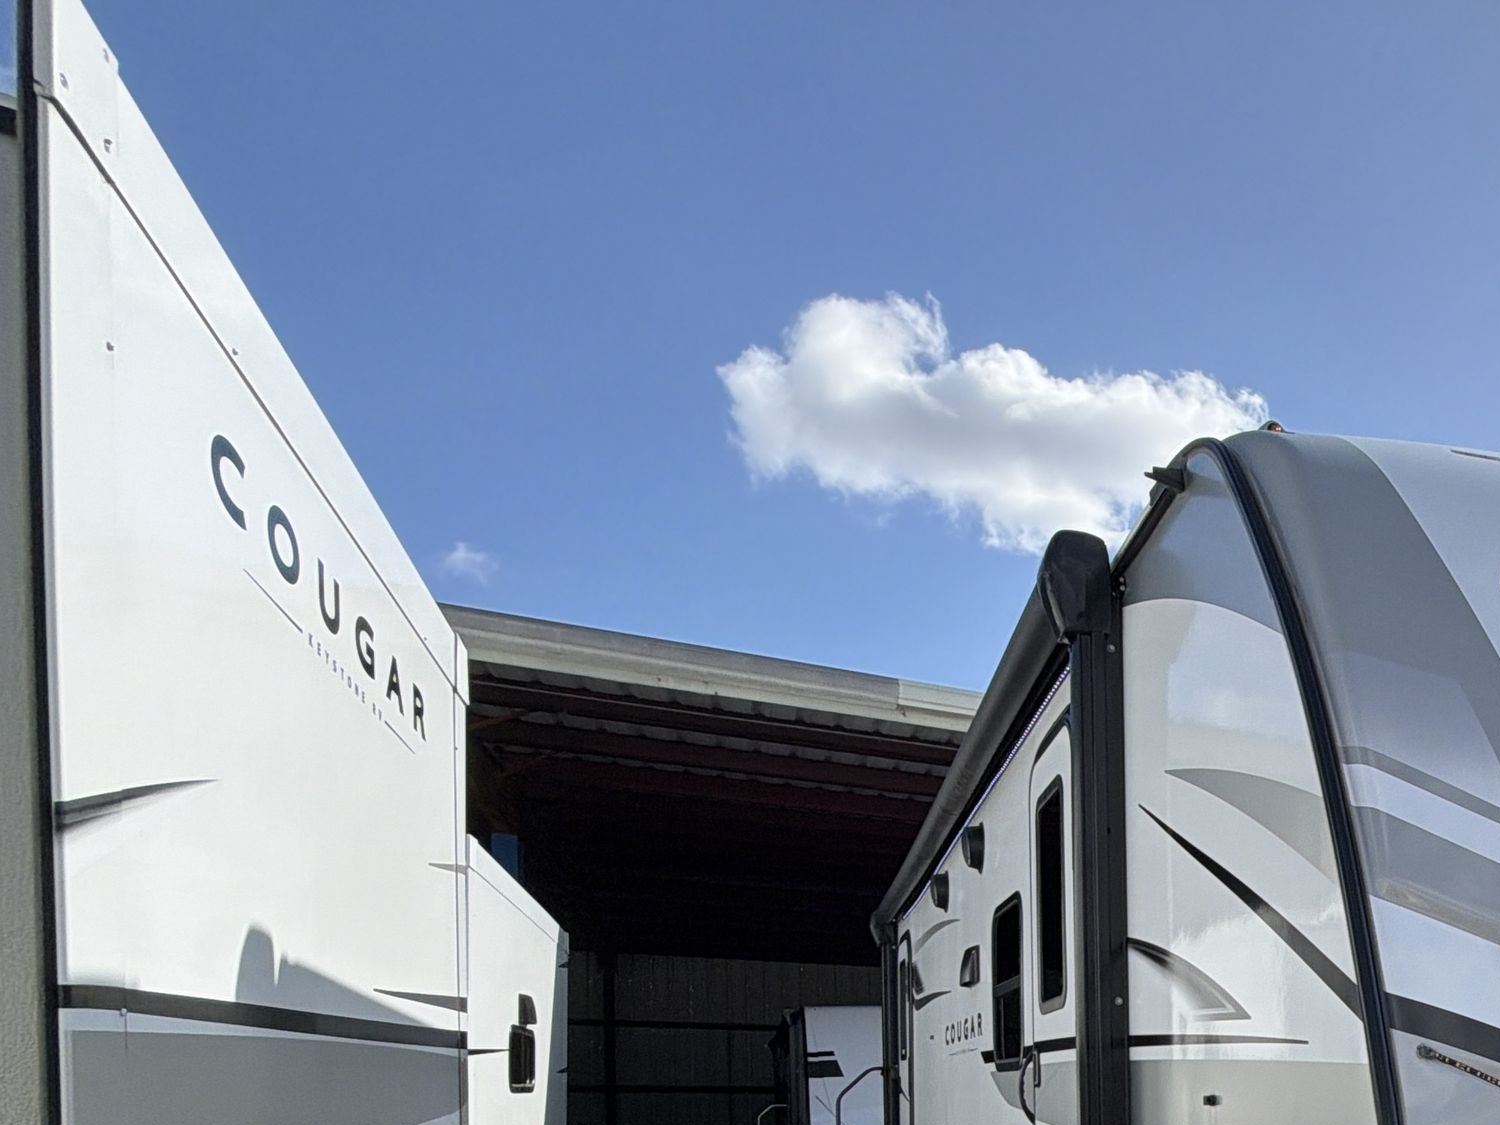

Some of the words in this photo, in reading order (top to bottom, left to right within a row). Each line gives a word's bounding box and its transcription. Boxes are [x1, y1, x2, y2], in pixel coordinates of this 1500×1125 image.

[210, 434, 427, 742] COUGAR
[308, 633, 366, 704] KEYSTONE
[945, 1012, 983, 1046] COUGAR
